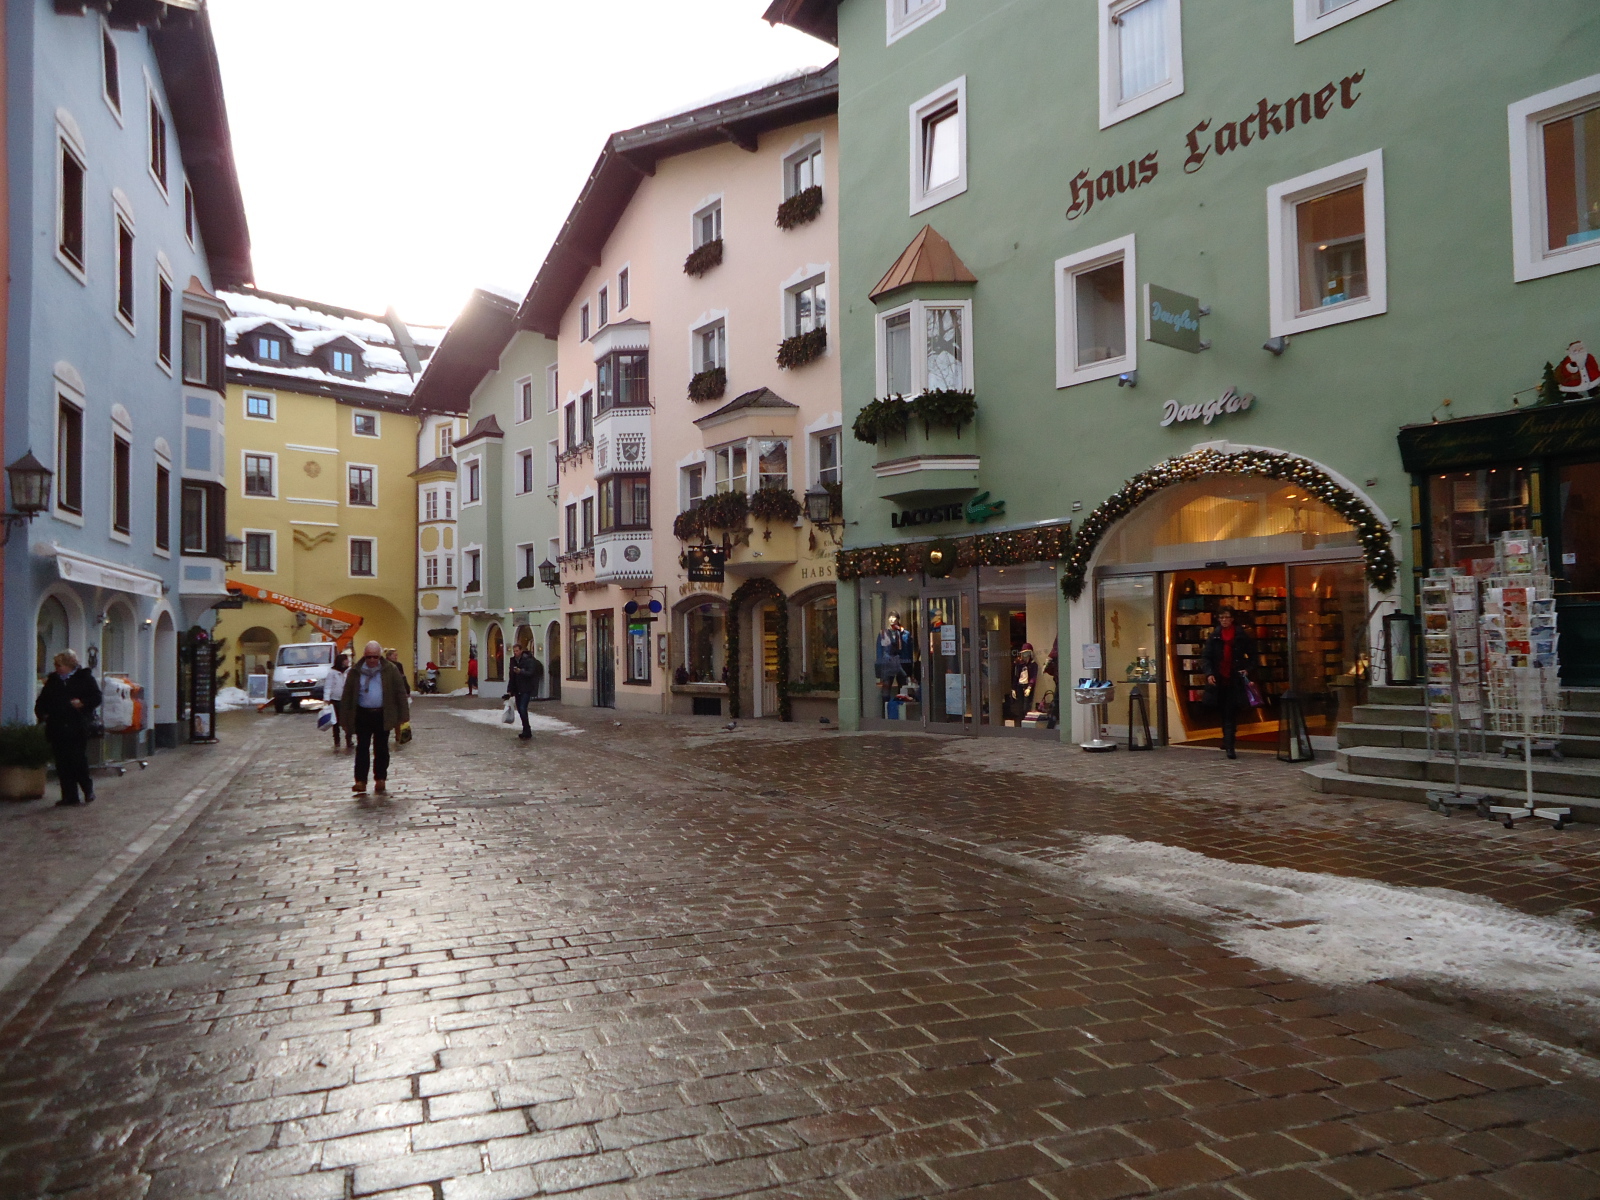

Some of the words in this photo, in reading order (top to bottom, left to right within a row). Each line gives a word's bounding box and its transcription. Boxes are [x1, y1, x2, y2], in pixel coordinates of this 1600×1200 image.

[1066, 150, 1158, 220] Haus
[1184, 68, 1366, 174] Lackner
[1152, 301, 1198, 332] Douglas
[1160, 385, 1256, 427] Douglas
[892, 503, 963, 528] LACOSTE
[272, 593, 333, 614] STADTWERKE
